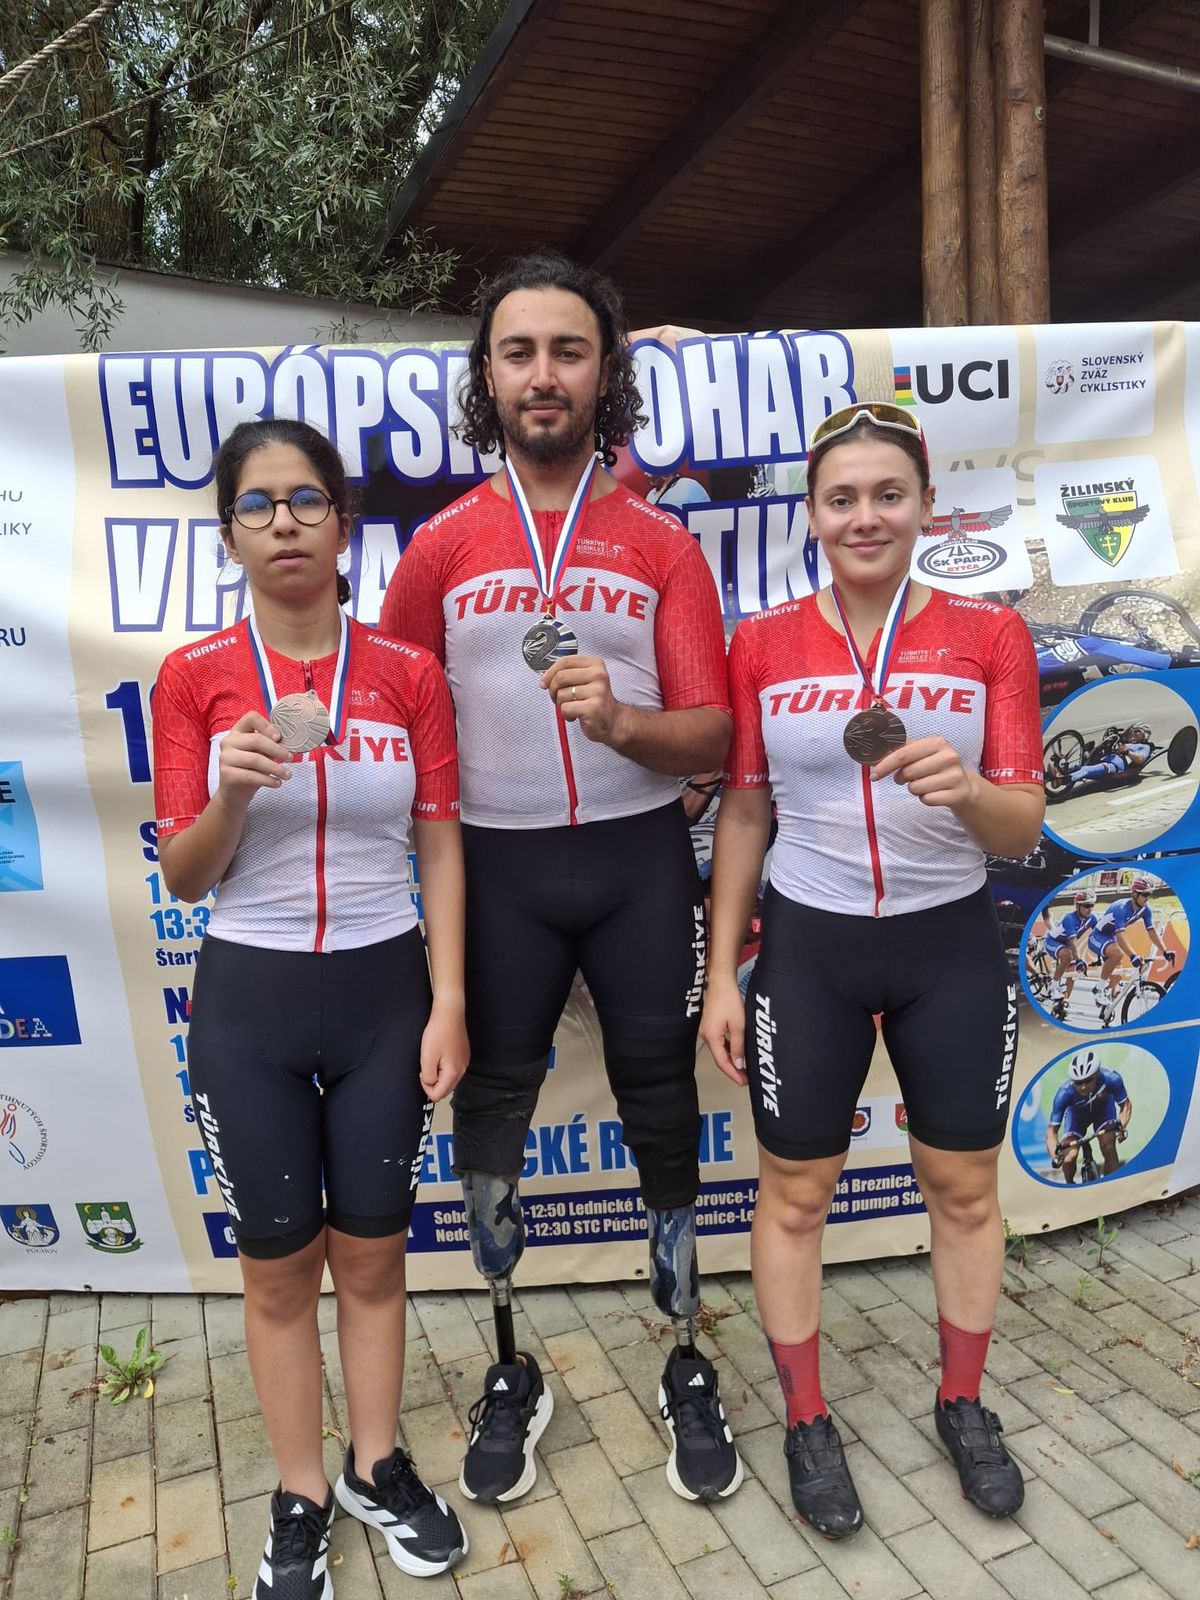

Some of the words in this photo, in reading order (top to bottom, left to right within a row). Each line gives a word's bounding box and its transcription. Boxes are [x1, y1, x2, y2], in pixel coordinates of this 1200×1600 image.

[1080, 367, 1108, 380] ZVÄZ
[1081, 351, 1144, 366] SLOVENSKÝ
[915, 358, 1010, 404] UCI
[1079, 379, 1146, 393] CYKLISTIKY
[630, 330, 858, 475] OHÁR
[1060, 477, 1135, 497] ŽILINSKÝ
[0, 522, 32, 536] IKY
[427, 493, 480, 532] TÜRKİYE
[626, 497, 681, 533] TÜRKİYE
[104, 517, 179, 633] V
[954, 554, 991, 565] PARA
[454, 576, 649, 622] TÜRKİYE
[749, 602, 800, 623] TÜRKİYE
[947, 598, 1001, 614] TÜRKİYE
[184, 635, 238, 662] TÜRKİYE
[367, 633, 421, 660] TÜRKİYE
[769, 679, 976, 717] TÜRKİYE
[149, 906, 211, 940] 13:3
[685, 904, 704, 1019] TÜRKİYE
[755, 993, 780, 1119] TÜRKİYE
[994, 983, 1018, 1111] TÜRKİYE
[195, 1092, 242, 1222] TÜRKİYE
[409, 1097, 434, 1191] TÜRKİ
[694, 1188, 759, 1207] orovce-L
[850, 1174, 917, 1193] Breznica-
[433, 1209, 469, 1225] Sobo
[520, 1202, 566, 1218] -12:50
[568, 1197, 633, 1217] Lednické
[694, 1208, 755, 1226] enice-Le
[828, 1200, 849, 1214] ne
[851, 1195, 900, 1214] pumpa
[901, 1191, 924, 1206] Slo
[435, 1228, 471, 1243] Nede
[523, 1220, 571, 1238] -12:30
[573, 1219, 601, 1235] STC
[602, 1216, 648, 1233] Púcho
